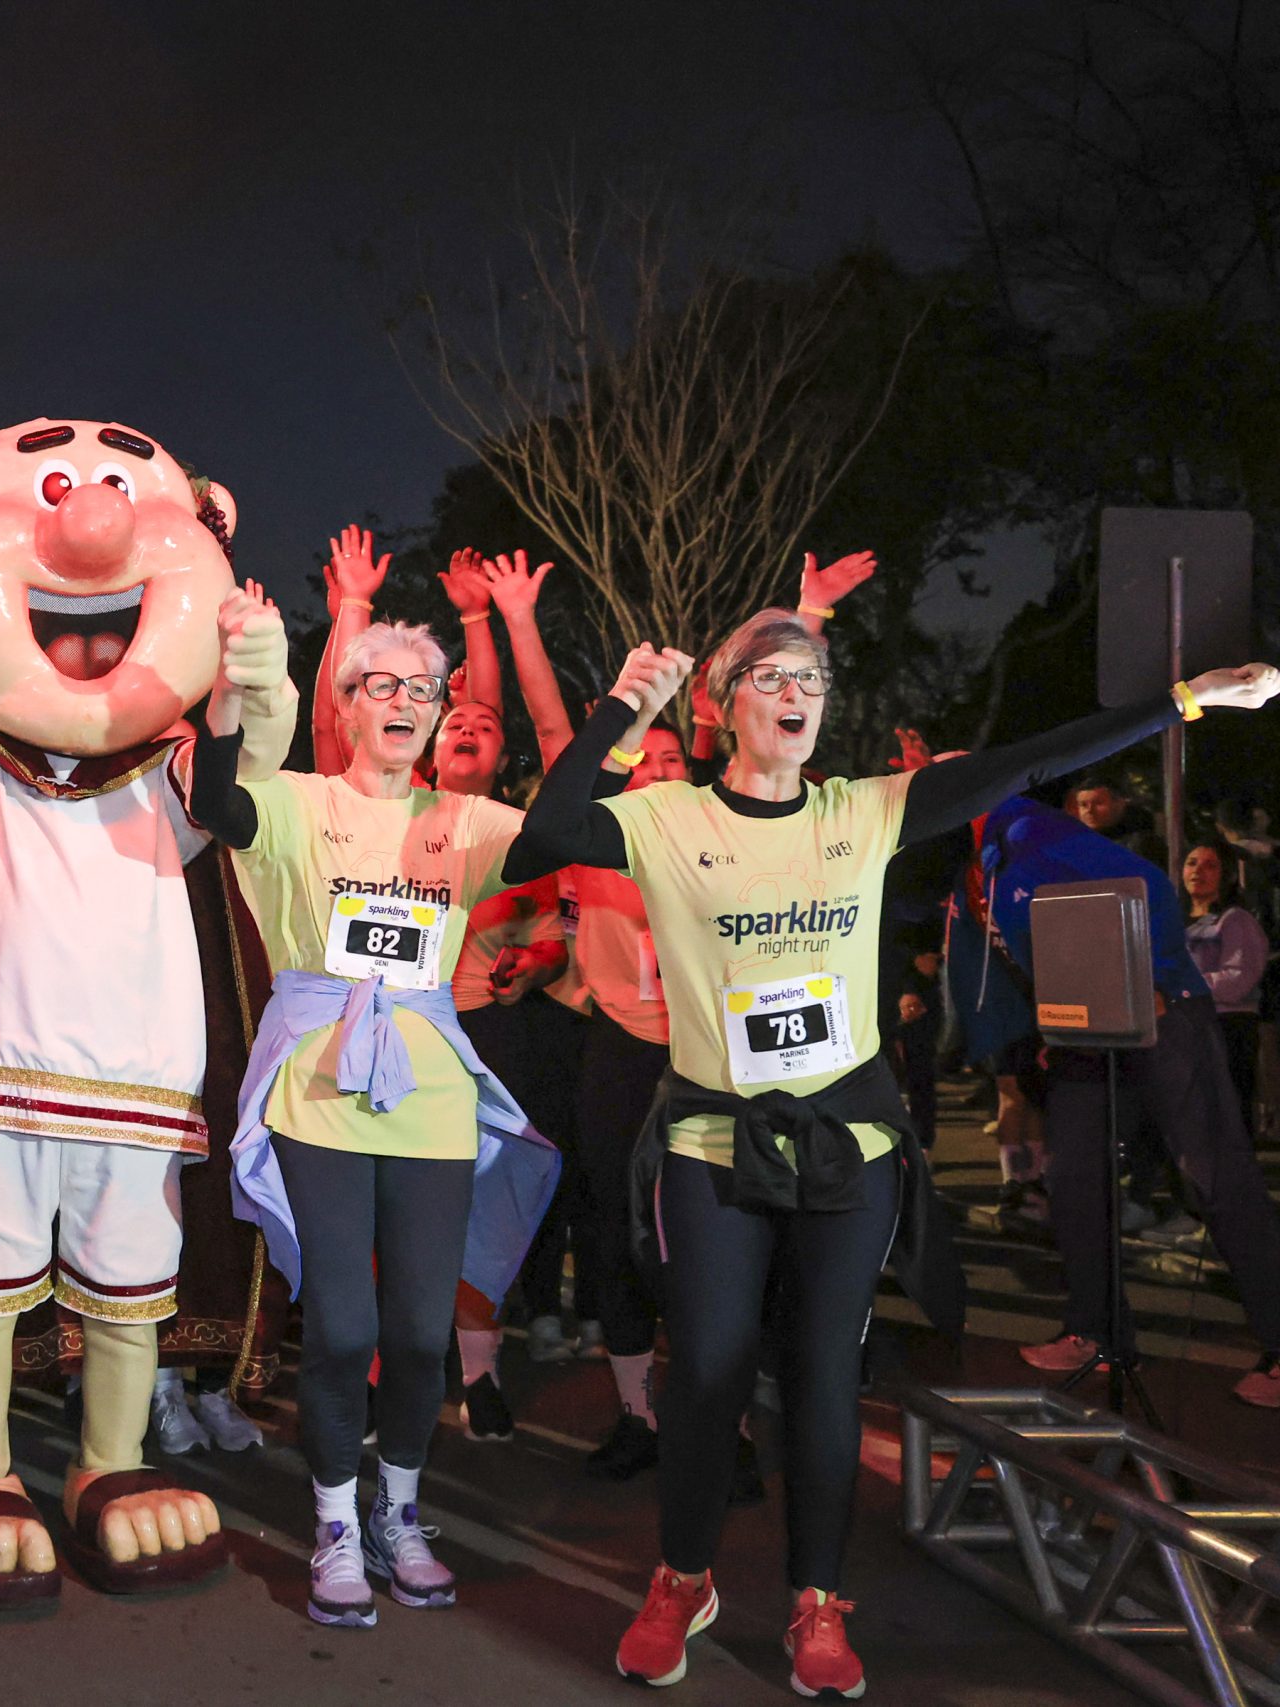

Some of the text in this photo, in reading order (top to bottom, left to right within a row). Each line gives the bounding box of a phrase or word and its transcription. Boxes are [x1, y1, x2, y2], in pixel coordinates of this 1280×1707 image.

[716, 853, 740, 865] CIC
[824, 840, 853, 861] LIVE!
[368, 904, 410, 919] sparkling
[718, 899, 859, 946] sparkling
[366, 927, 401, 956] 82
[417, 929, 430, 970] CAMINHADA
[757, 936, 830, 959] night run
[374, 959, 389, 967] GENI
[759, 988, 805, 1005] sparkling
[769, 1013, 807, 1046] 78
[824, 1000, 838, 1047] CAMINHADA
[779, 1047, 810, 1059] MARINES
